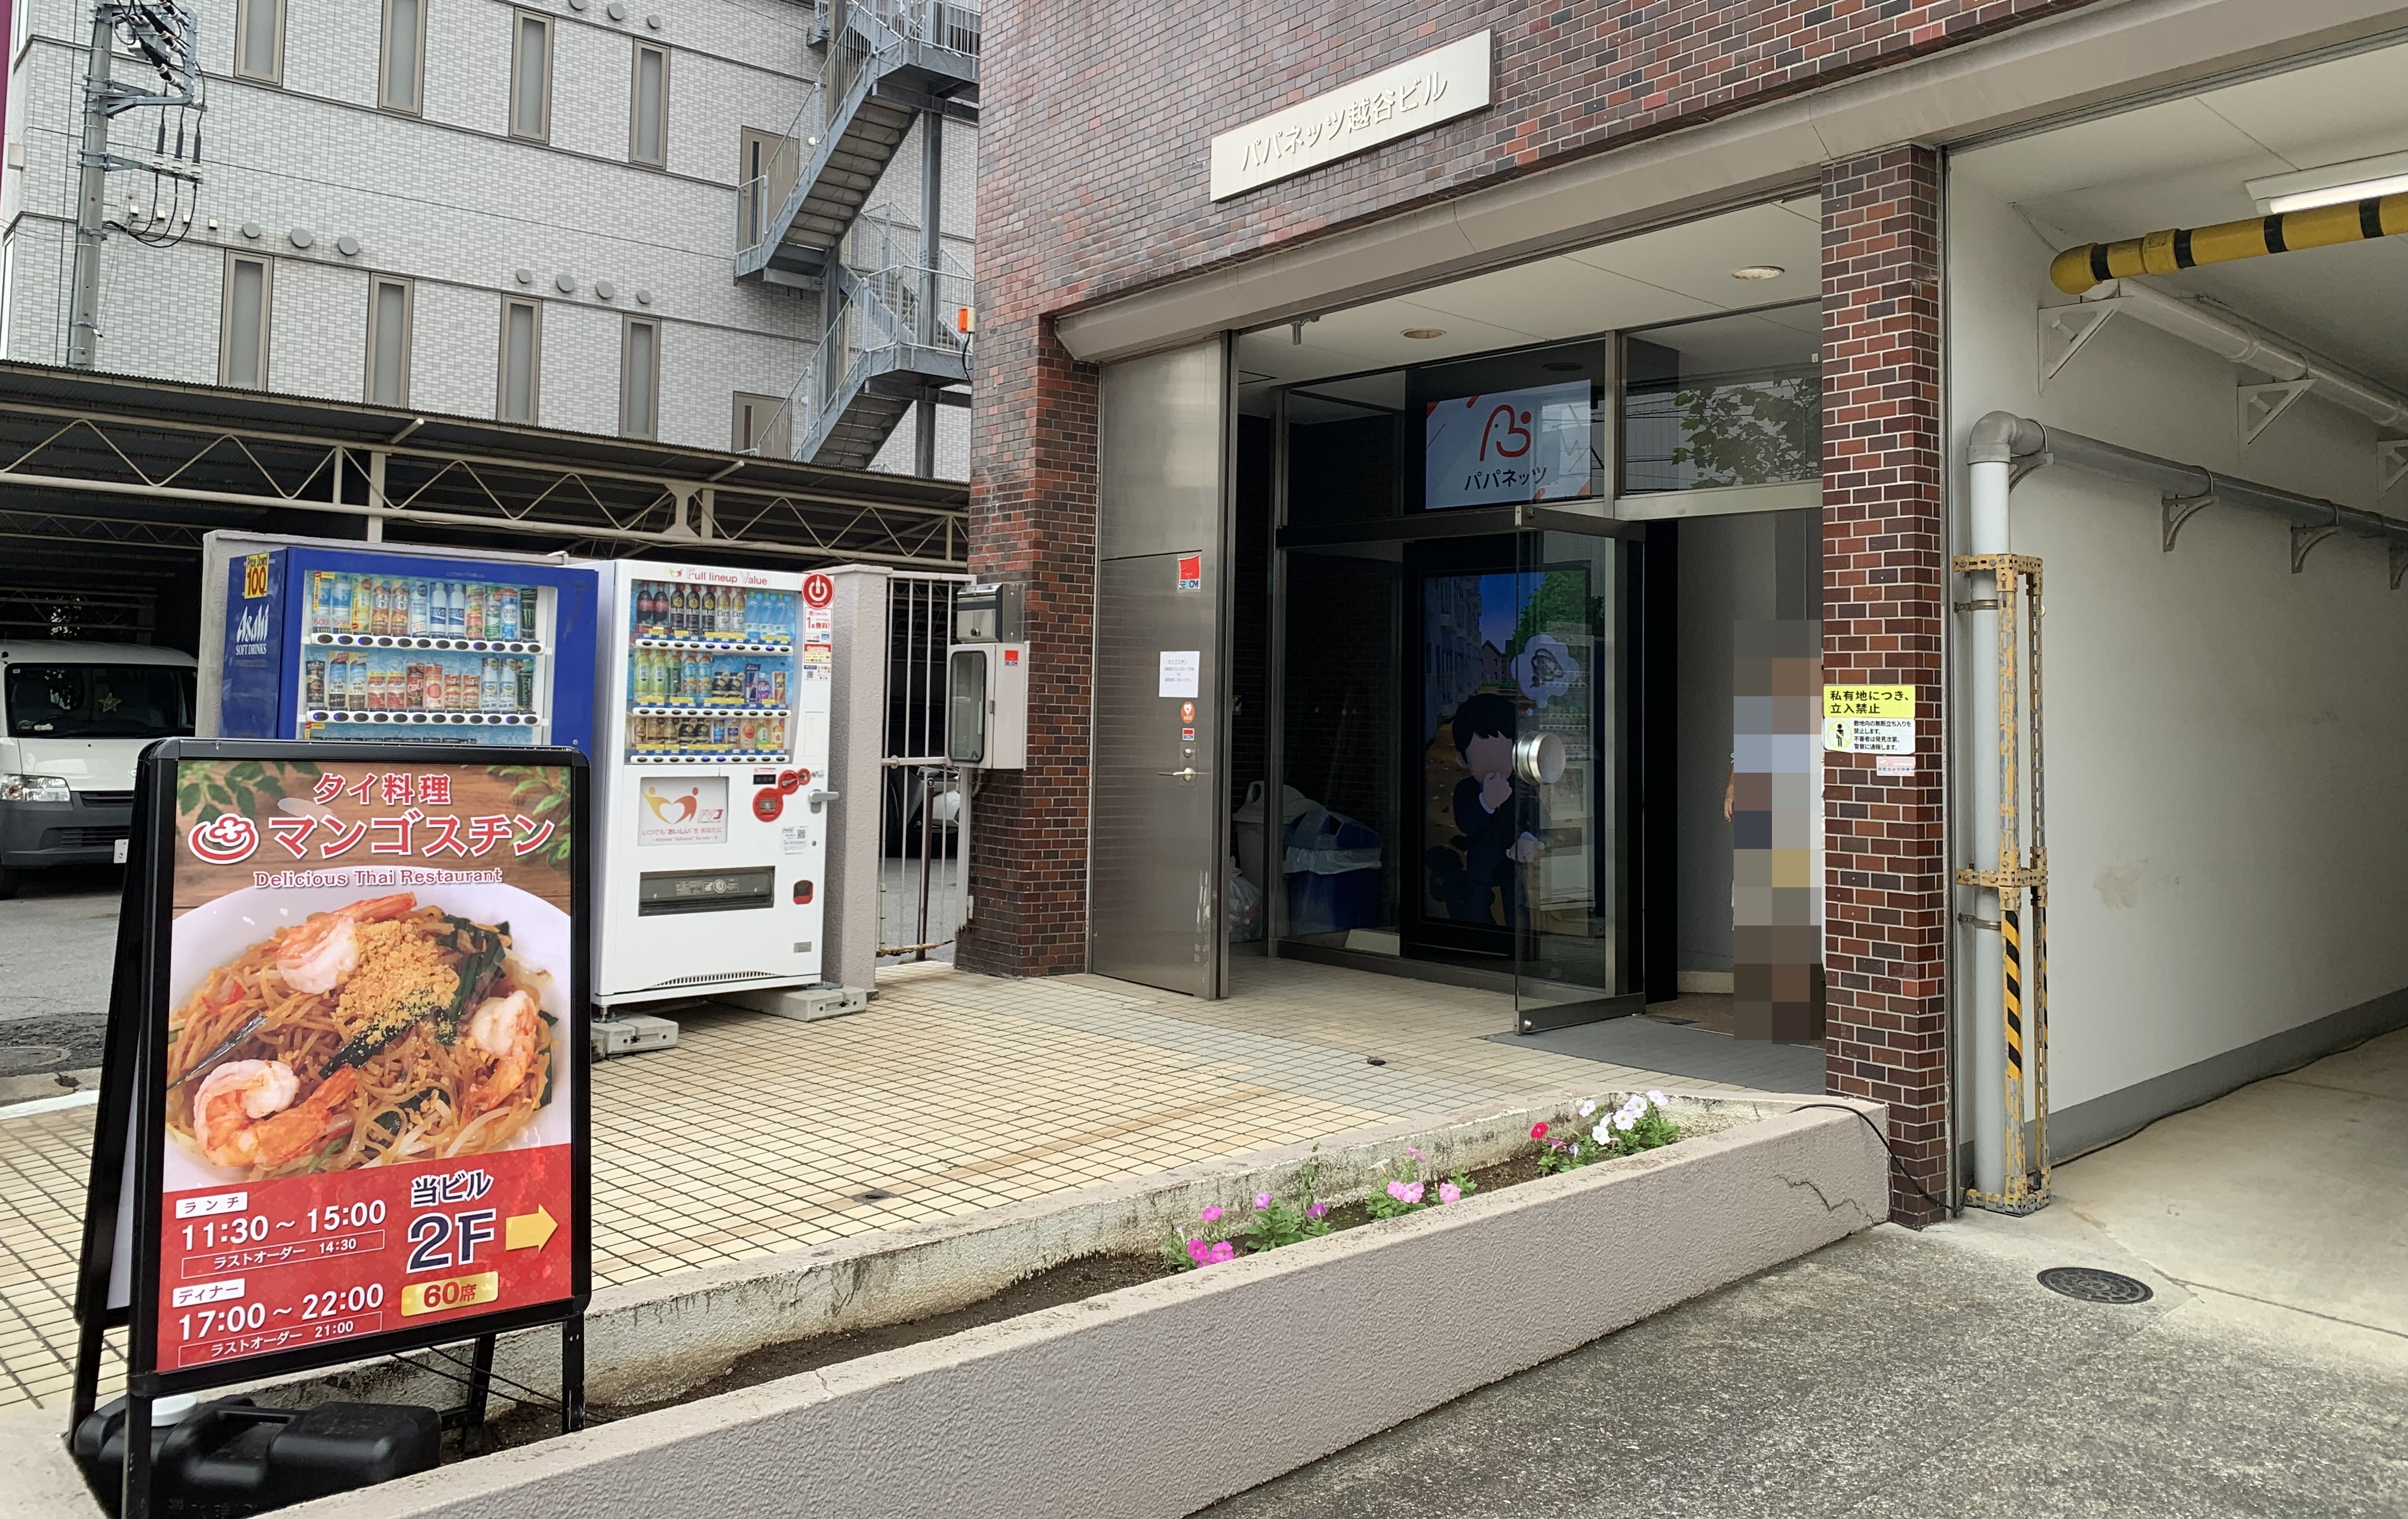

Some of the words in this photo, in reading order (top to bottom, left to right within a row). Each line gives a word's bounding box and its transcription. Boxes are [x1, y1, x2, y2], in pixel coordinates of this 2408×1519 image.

[1240, 71, 1448, 171] パパネッツ越谷ビル
[1464, 467, 1547, 491] パパネッツ
[687, 567, 706, 580] Full
[709, 571, 738, 584] lineup
[740, 571, 767, 585] Value
[236, 604, 269, 643] Asahi
[236, 644, 248, 656] SOFT
[248, 643, 266, 655] DRINKS
[1830, 690, 1909, 701] 私有地につき、
[1830, 703, 1881, 714] 立入禁止
[314, 773, 451, 805] タイ料理
[269, 807, 554, 860] マンゴスチン
[254, 870, 348, 888] Delicious
[355, 869, 395, 886] Thai
[400, 867, 502, 885] Restaurant
[411, 1170, 494, 1207] 当ビル
[183, 1195, 241, 1214] ランチ
[213, 1247, 306, 1271] ラストオーダー
[318, 1237, 357, 1254] 14:30
[406, 1208, 497, 1274] 2F
[179, 1284, 239, 1303] ディナー
[423, 1281, 477, 1308] 60席
[211, 1333, 303, 1357] ラストオーダー
[315, 1320, 354, 1338] 21:00
